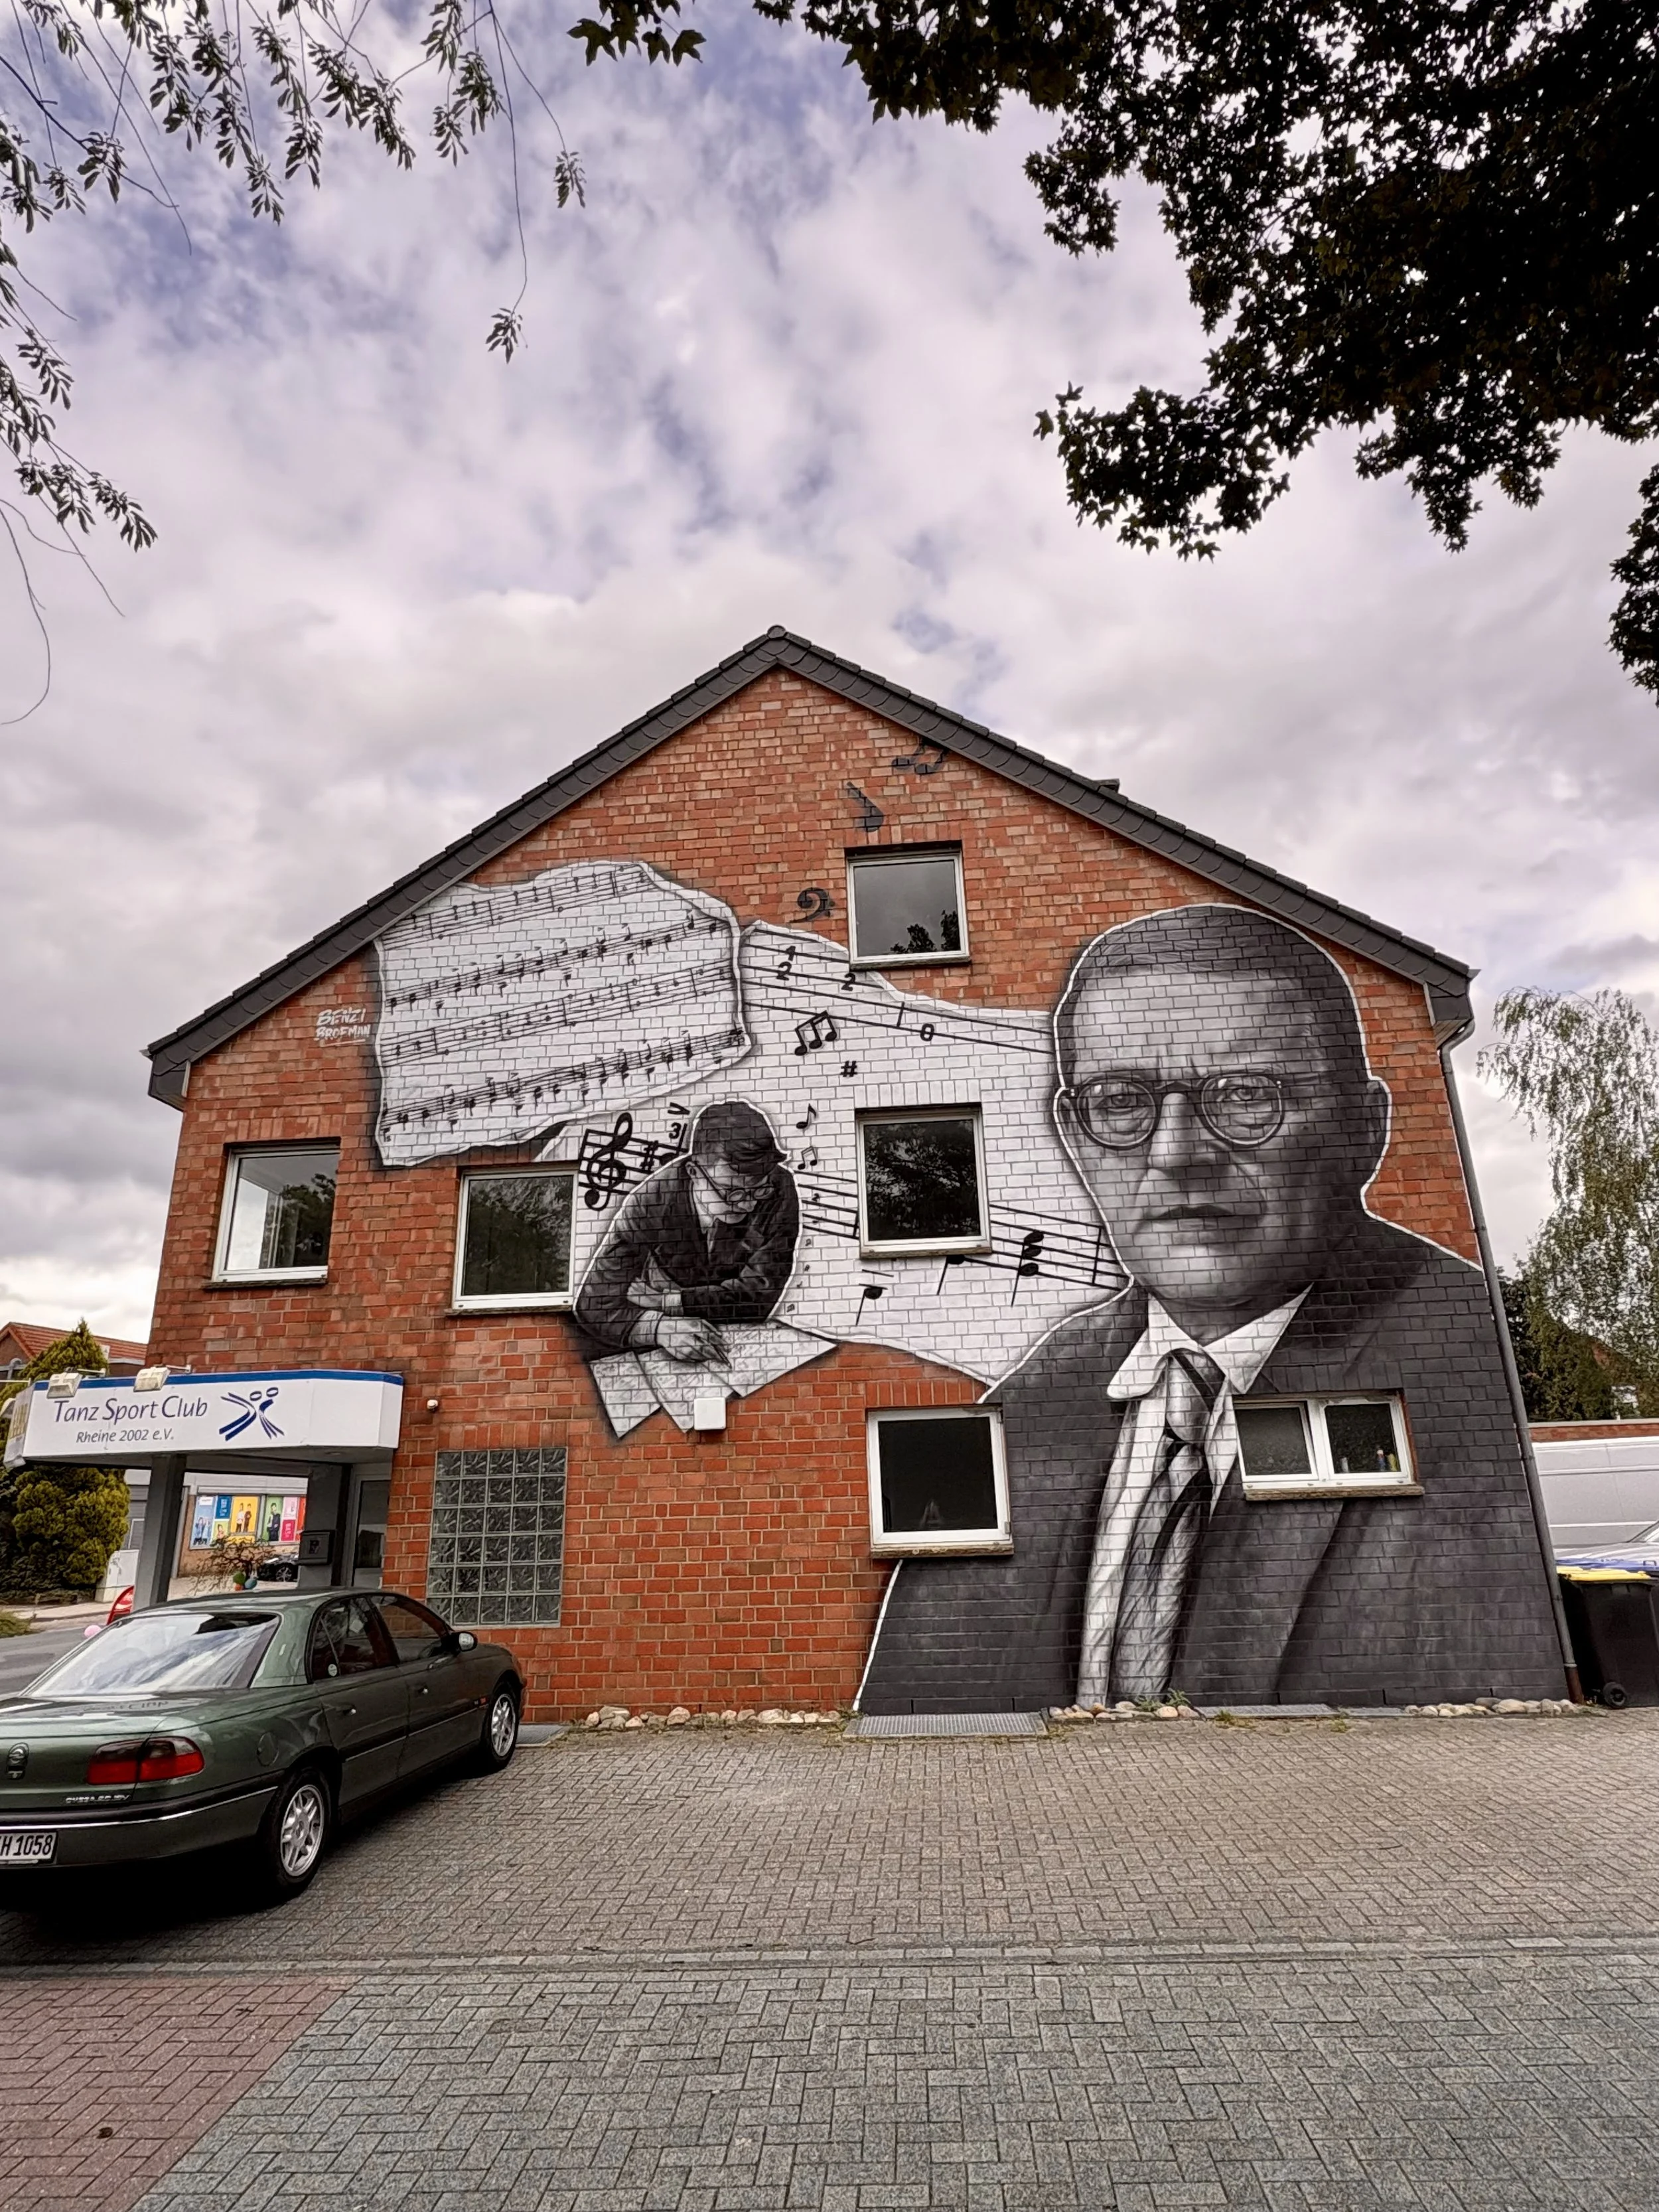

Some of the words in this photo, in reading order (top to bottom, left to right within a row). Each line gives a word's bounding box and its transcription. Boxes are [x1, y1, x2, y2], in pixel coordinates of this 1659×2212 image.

[317, 1007, 366, 1025] BENZI
[54, 1400, 99, 1423] Tanz
[102, 1398, 159, 1425] Sport
[161, 1395, 208, 1418] Club
[76, 1429, 116, 1443] Rheine
[119, 1429, 148, 1442] 2002
[153, 1428, 175, 1441] e.V.
[0, 1836, 13, 1856] H
[13, 1834, 53, 1856] 1058
